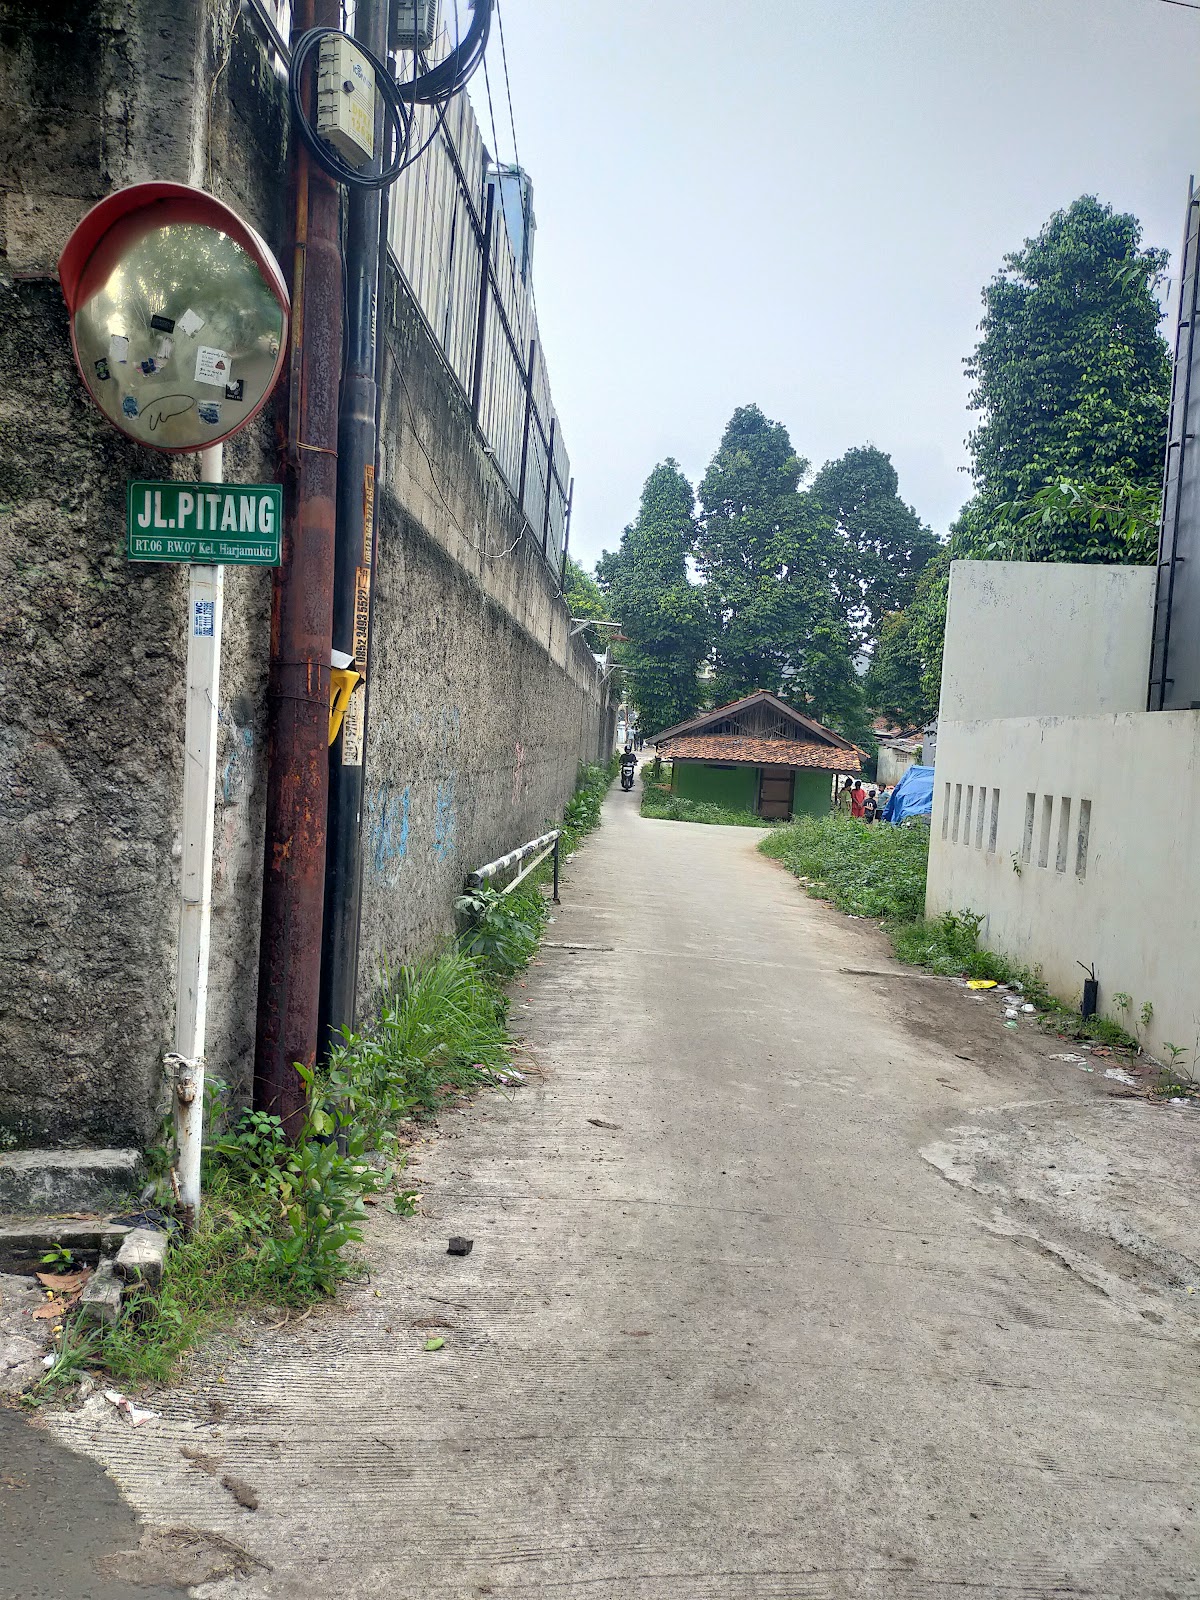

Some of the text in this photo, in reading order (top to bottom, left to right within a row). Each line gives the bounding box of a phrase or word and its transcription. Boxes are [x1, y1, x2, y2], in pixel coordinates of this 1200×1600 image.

[366, 504, 374, 518] 777
[365, 522, 373, 539] 966
[135, 539, 272, 558] RT.06 RW.07 Kel. Harjamukti
[365, 541, 373, 562] 0812
[195, 602, 203, 614] WC
[357, 589, 369, 613] 5522
[356, 613, 368, 638] 3493
[355, 639, 367, 663] 0852
